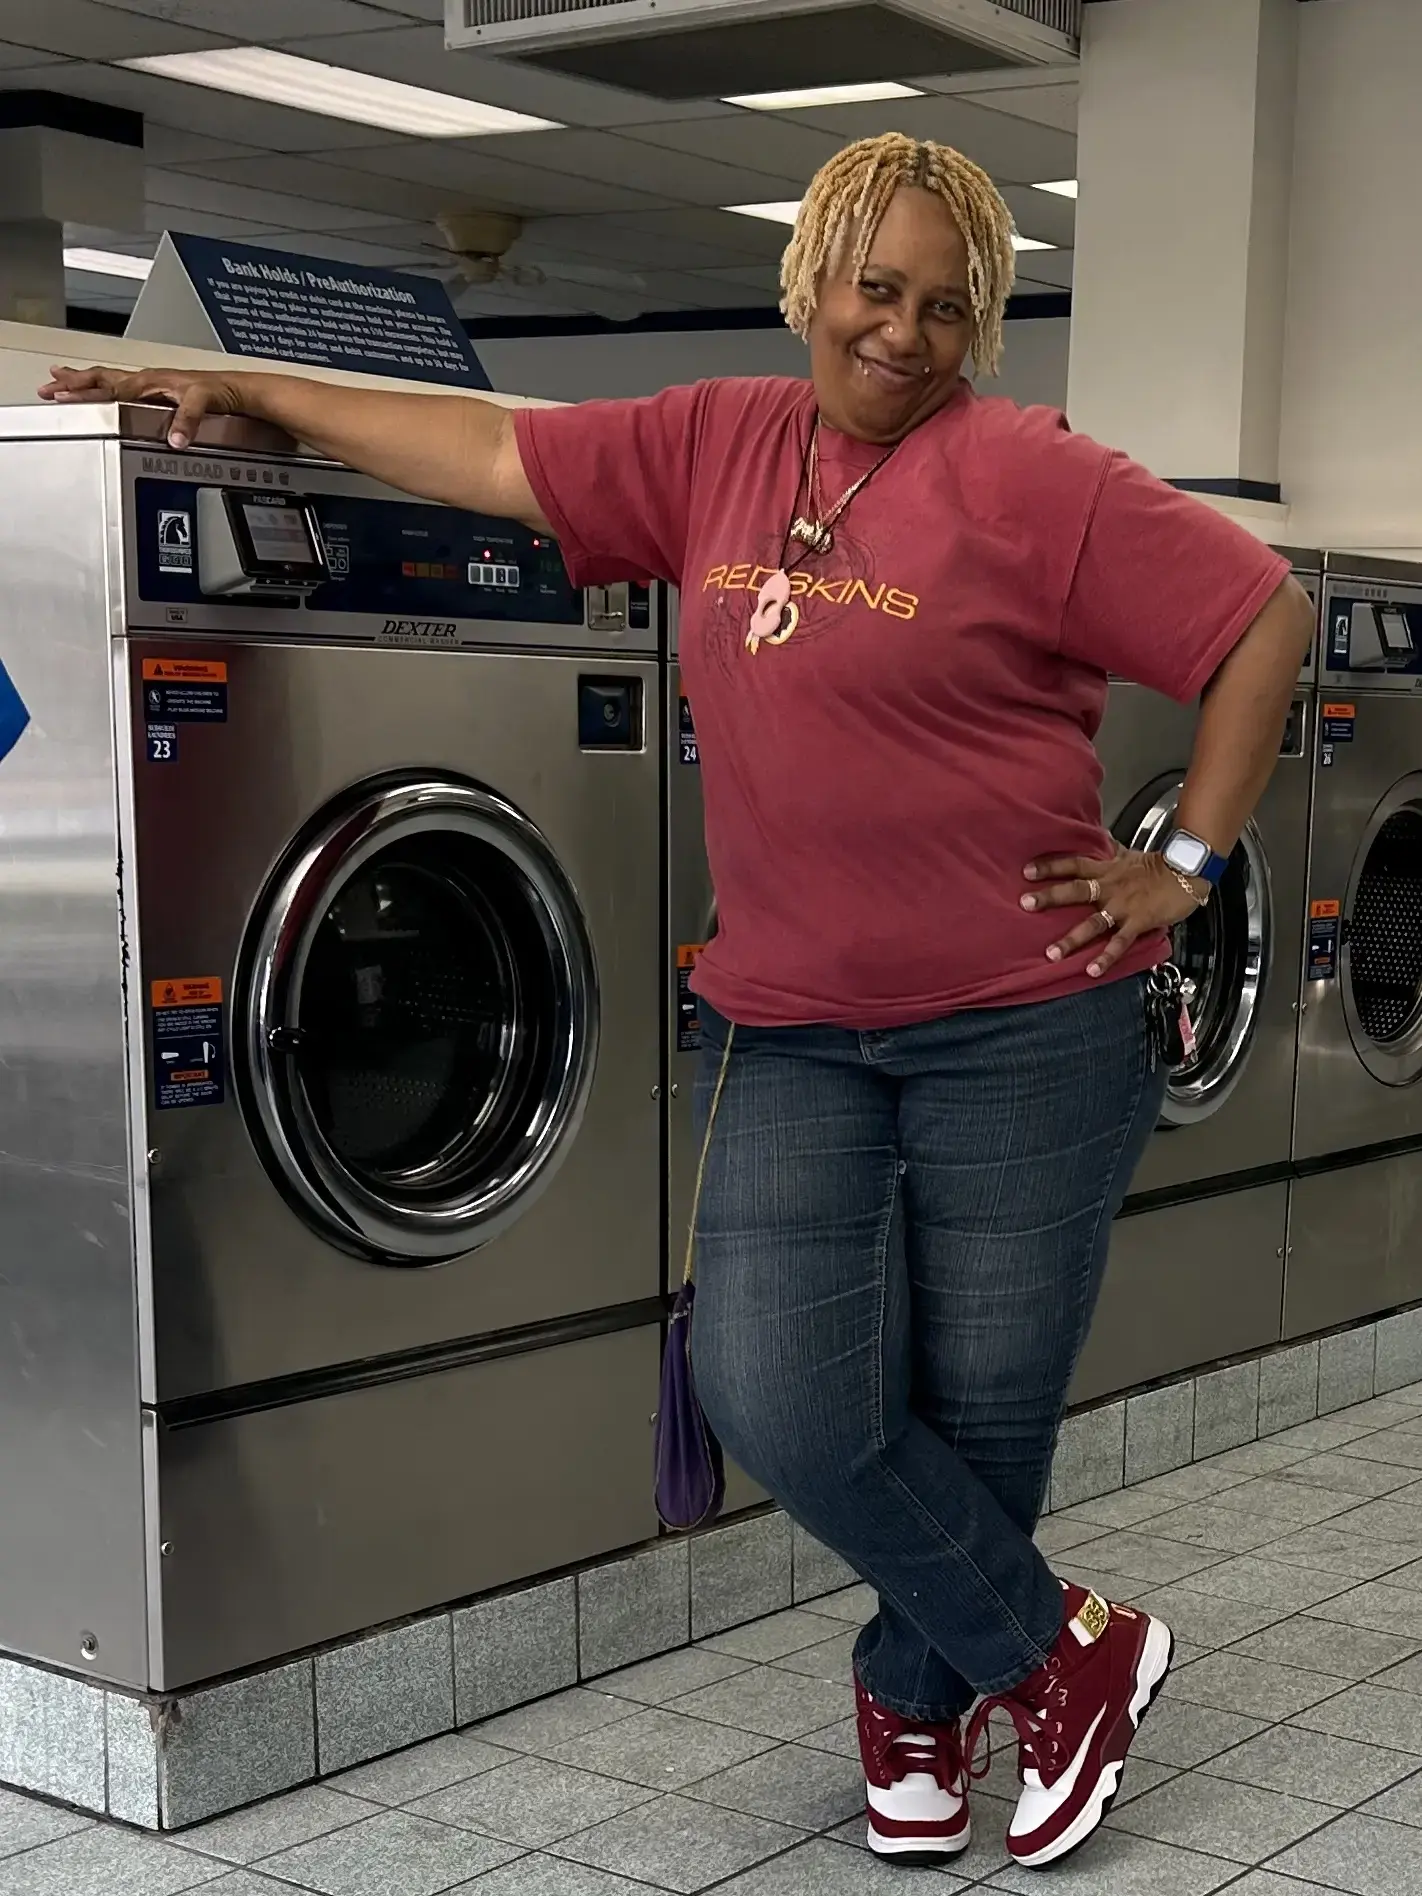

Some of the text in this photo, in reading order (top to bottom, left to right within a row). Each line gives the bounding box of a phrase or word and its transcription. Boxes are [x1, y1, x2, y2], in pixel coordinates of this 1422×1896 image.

[222, 257, 416, 304] Bank Holds / PreAuthorization
[216, 281, 230, 289] you
[230, 283, 243, 291] are
[243, 285, 269, 297] paying
[279, 291, 300, 300] credit
[309, 295, 327, 304] debit
[142, 457, 224, 480] MAXI LOAD
[381, 620, 456, 637] DEXTER
[153, 740, 171, 758] 23
[684, 746, 697, 761] 24
